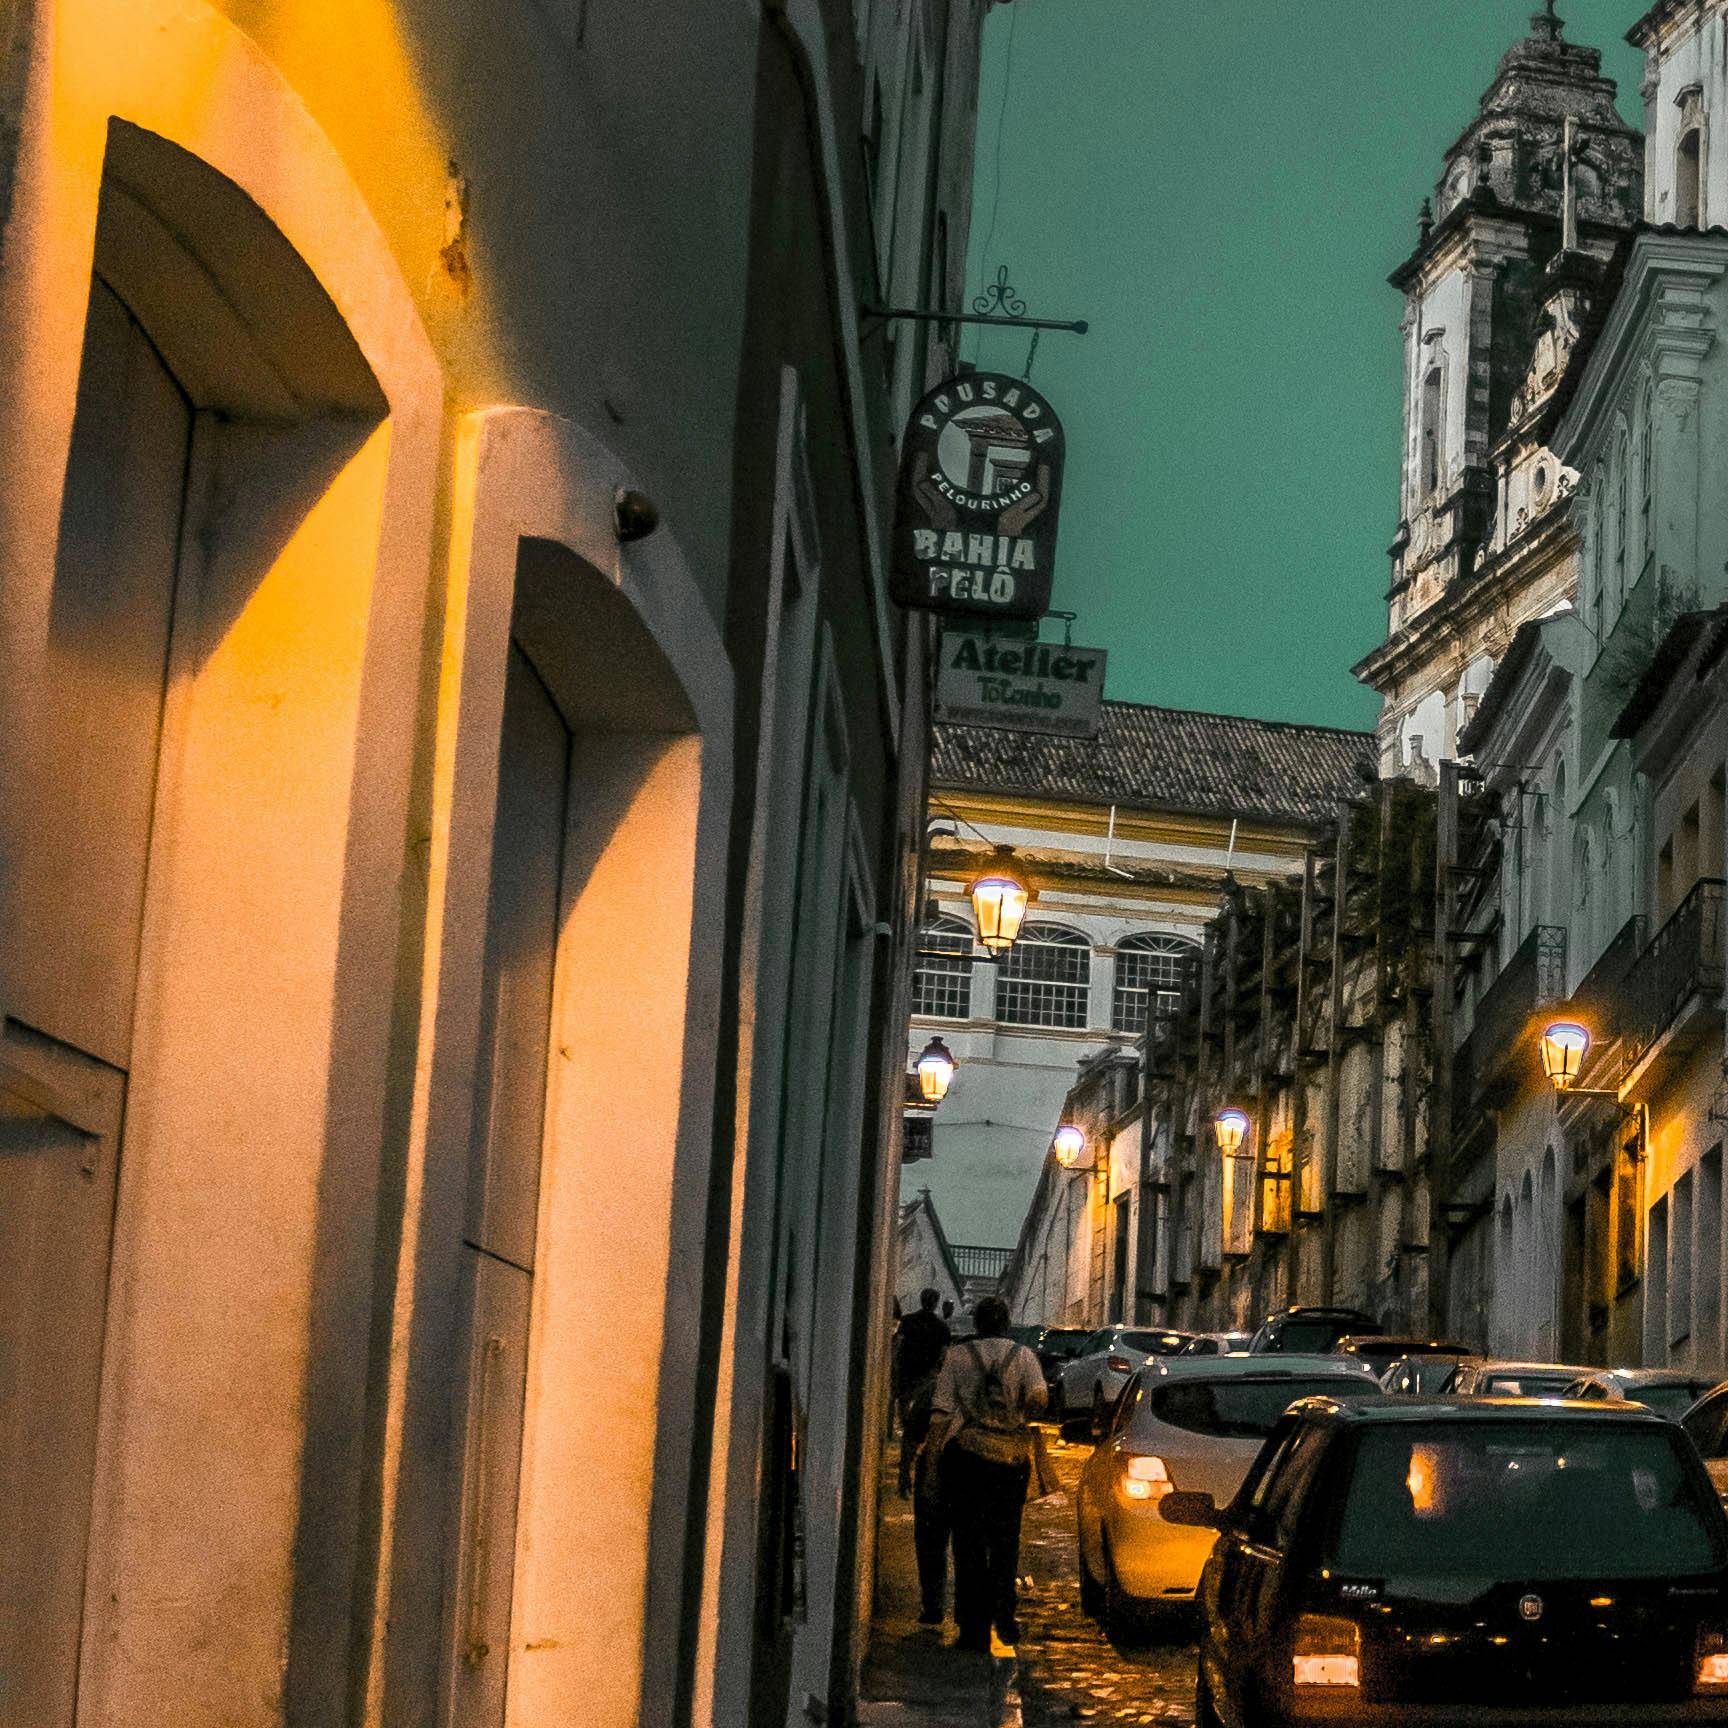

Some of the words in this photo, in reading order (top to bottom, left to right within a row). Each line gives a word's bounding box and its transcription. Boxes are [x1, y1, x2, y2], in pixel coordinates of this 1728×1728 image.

[920, 381, 1054, 444] POUSADA
[930, 472, 1032, 510] PELOURINHO
[912, 529, 1036, 571] BAHIA
[928, 566, 1015, 603] PELÔ
[950, 638, 1097, 684] Atelier
